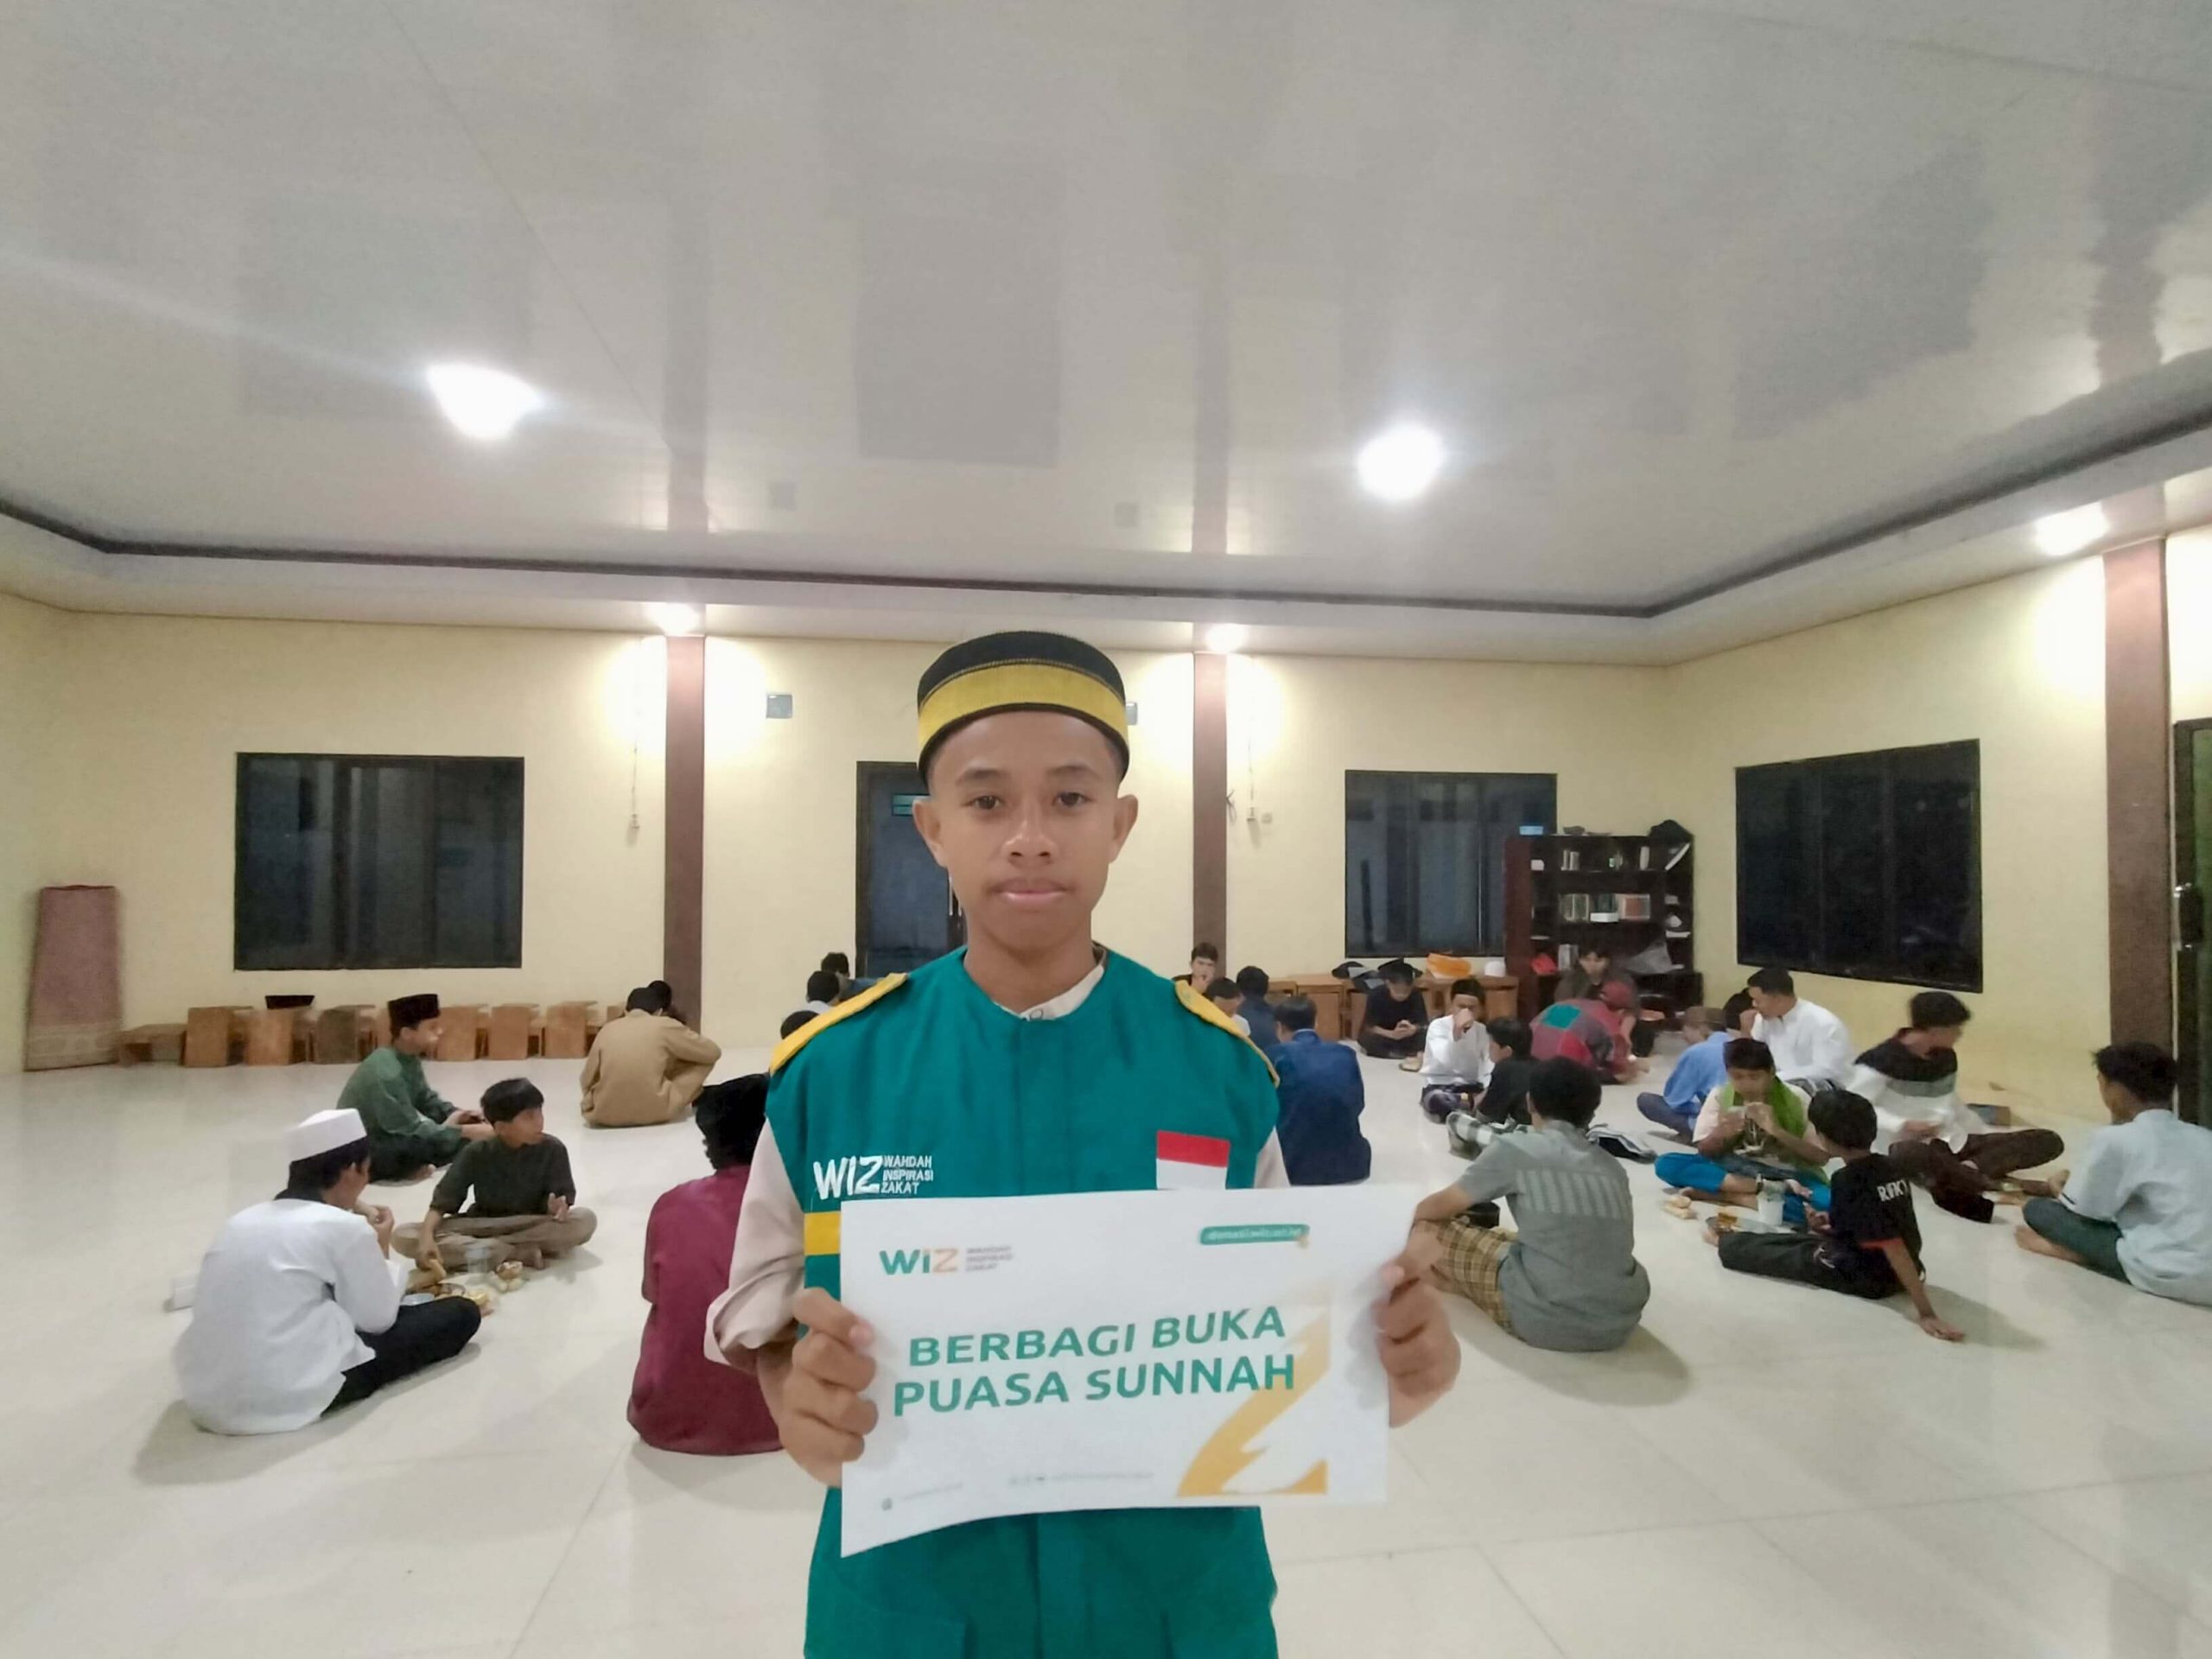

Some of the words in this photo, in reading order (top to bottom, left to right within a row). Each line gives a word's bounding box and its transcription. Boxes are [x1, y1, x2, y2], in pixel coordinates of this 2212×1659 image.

[882, 1169, 934, 1181] INSPIRASI
[884, 1155, 932, 1167] WAHDAH
[813, 1155, 883, 1200] WIZ
[880, 1181, 920, 1194] ZAKAT
[910, 1323, 1135, 1366] BERBAGI
[1152, 1306, 1285, 1348] BUKA
[894, 1370, 1070, 1416] PUASA
[1085, 1354, 1294, 1400] SUNNAH
